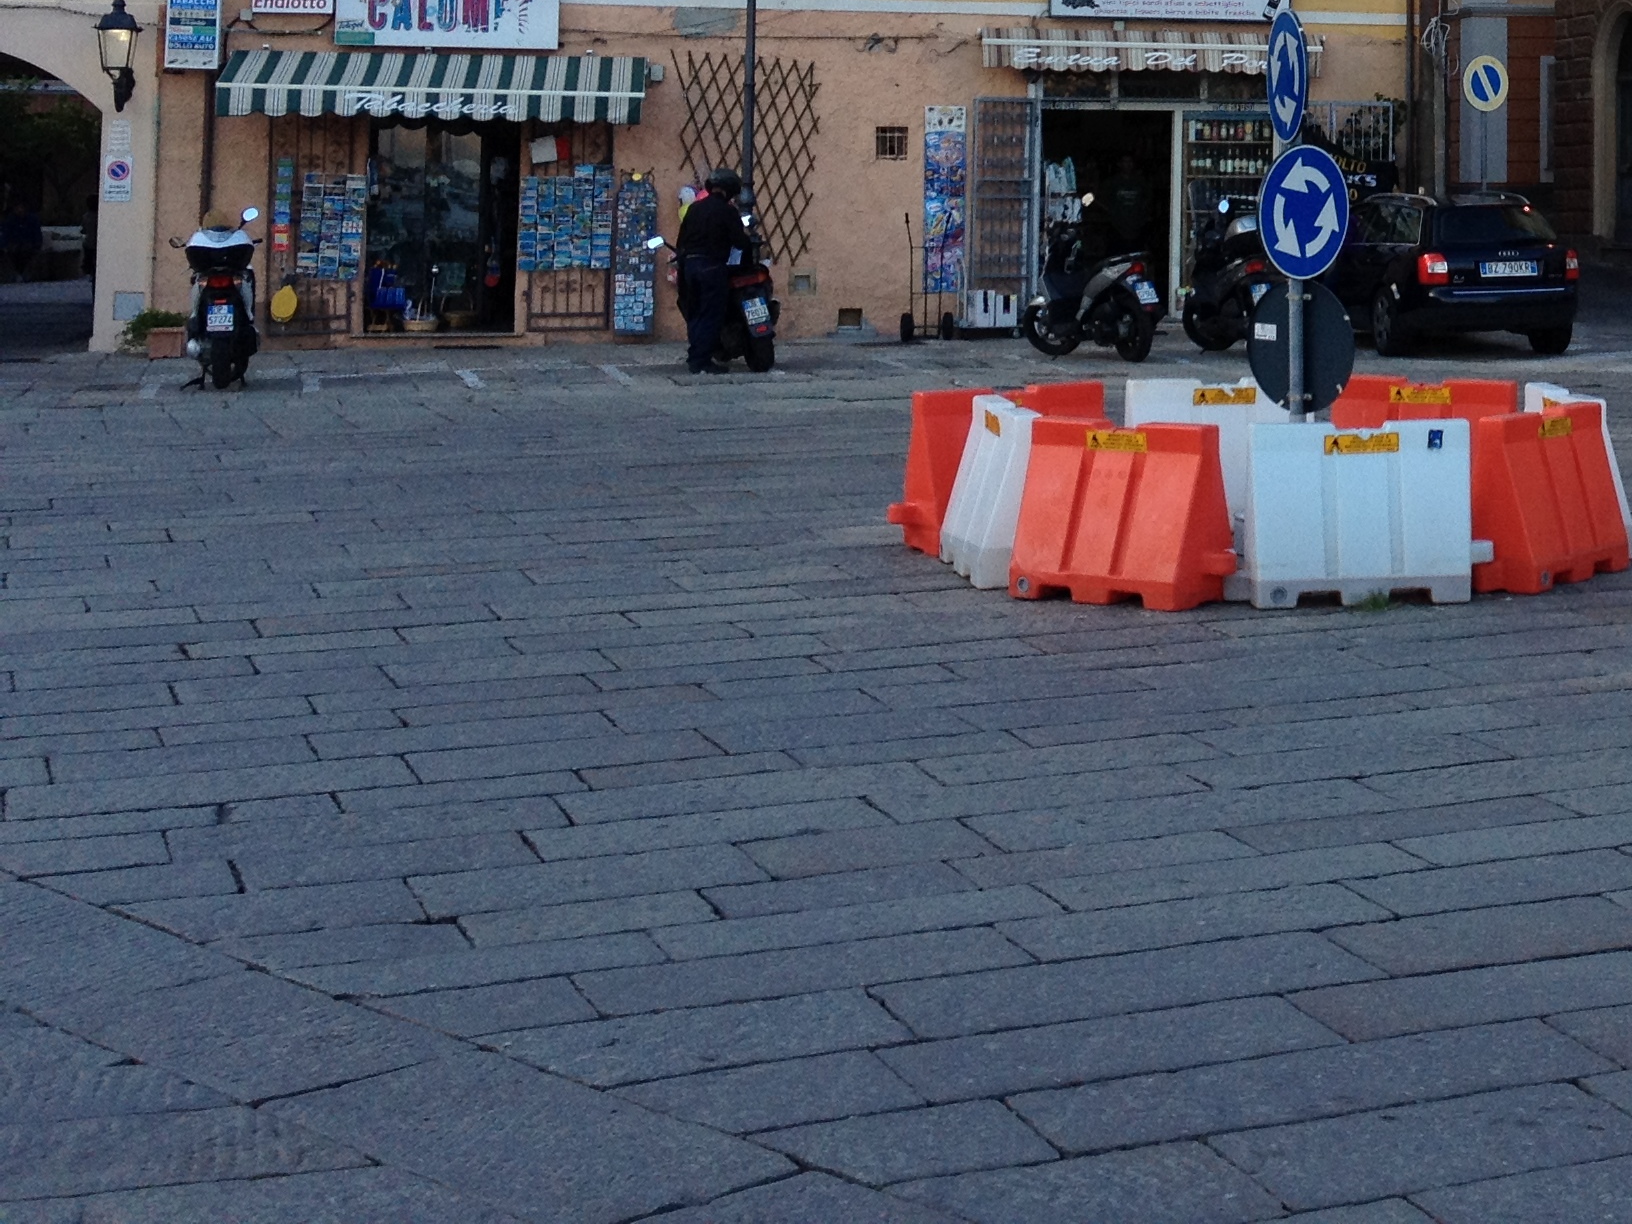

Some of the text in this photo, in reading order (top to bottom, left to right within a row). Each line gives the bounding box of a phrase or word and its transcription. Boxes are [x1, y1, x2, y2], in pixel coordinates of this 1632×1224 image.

[1142, 0, 1163, 7] sardi
[1012, 47, 1268, 70] Enoteca Del Por
[345, 92, 518, 115] Tabaccheria
